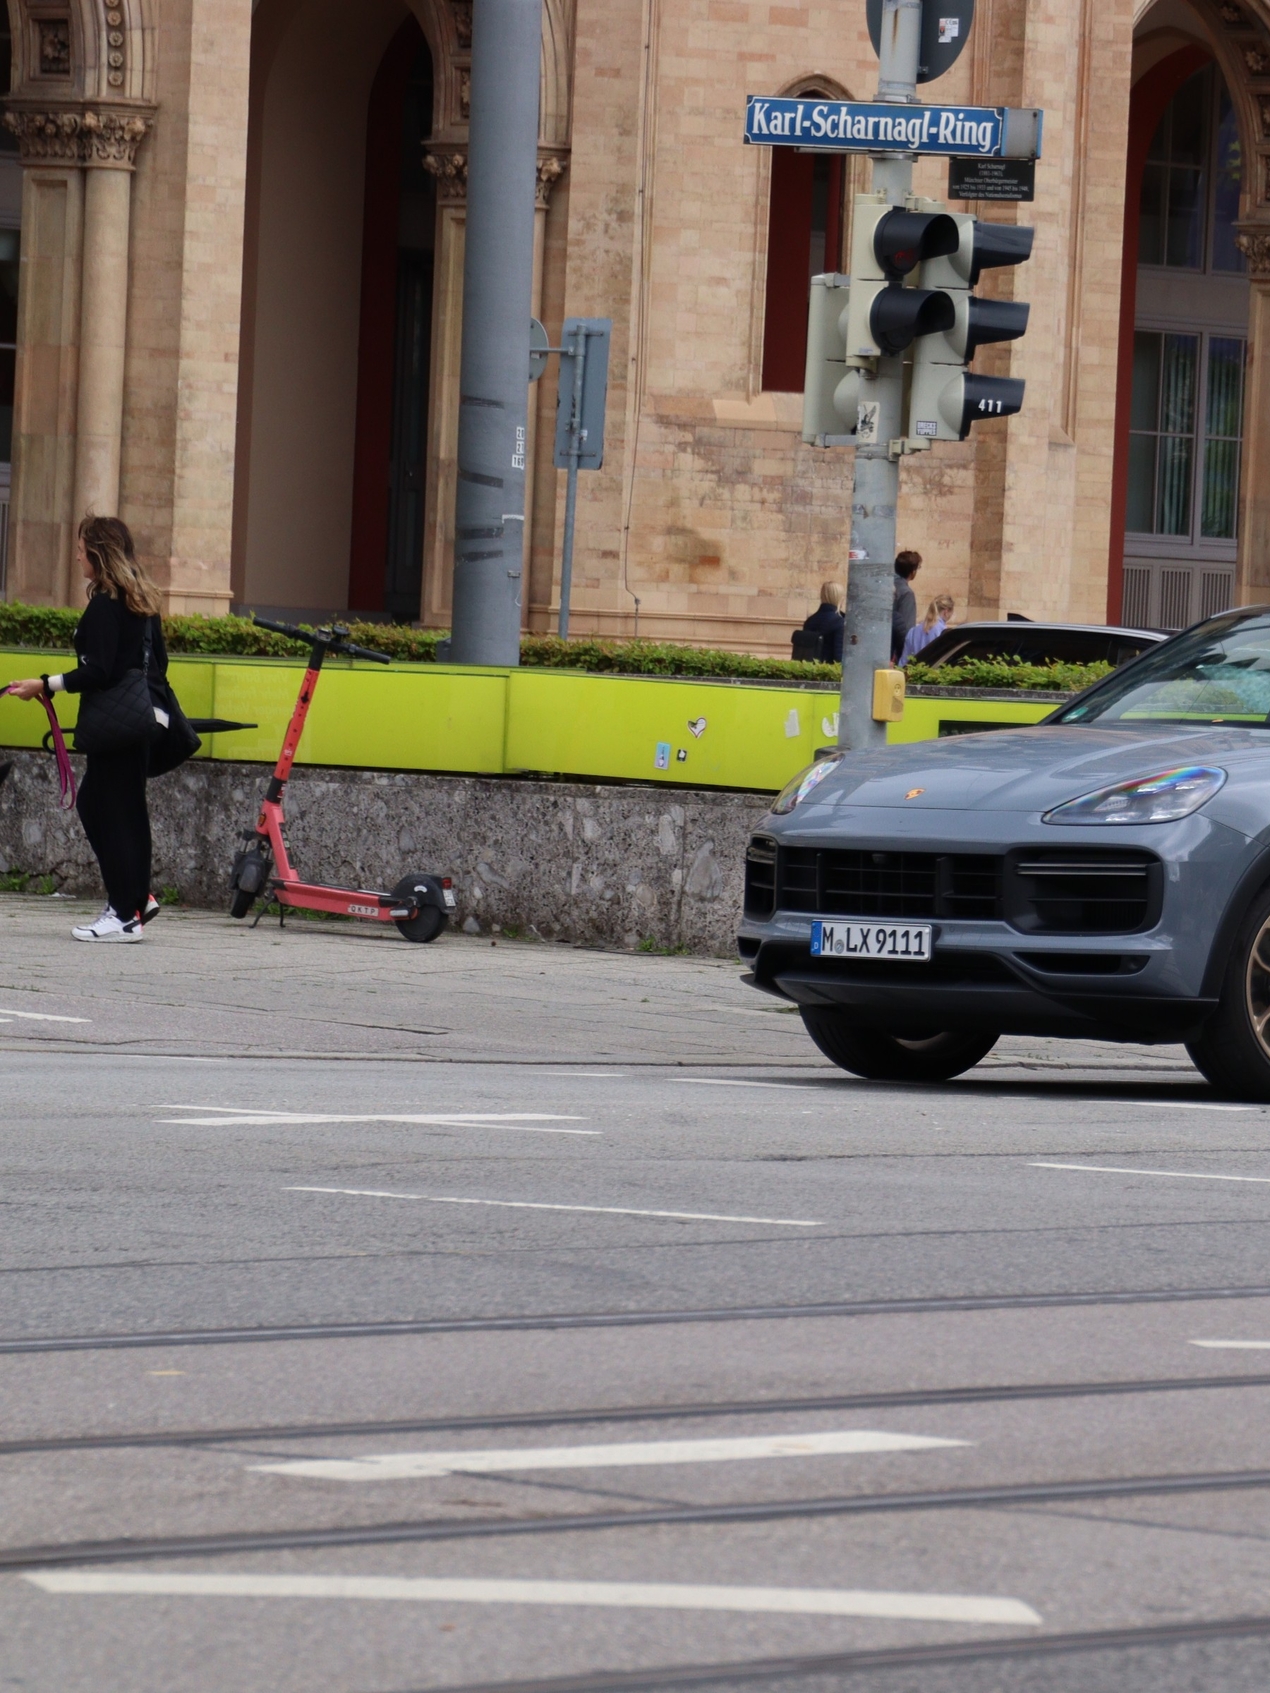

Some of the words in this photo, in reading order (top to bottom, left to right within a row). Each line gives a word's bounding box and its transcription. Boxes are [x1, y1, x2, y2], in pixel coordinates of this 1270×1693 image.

[751, 102, 994, 150] Karl-Scharnagl-Ring
[978, 398, 1002, 414] 411
[822, 927, 834, 952] M
